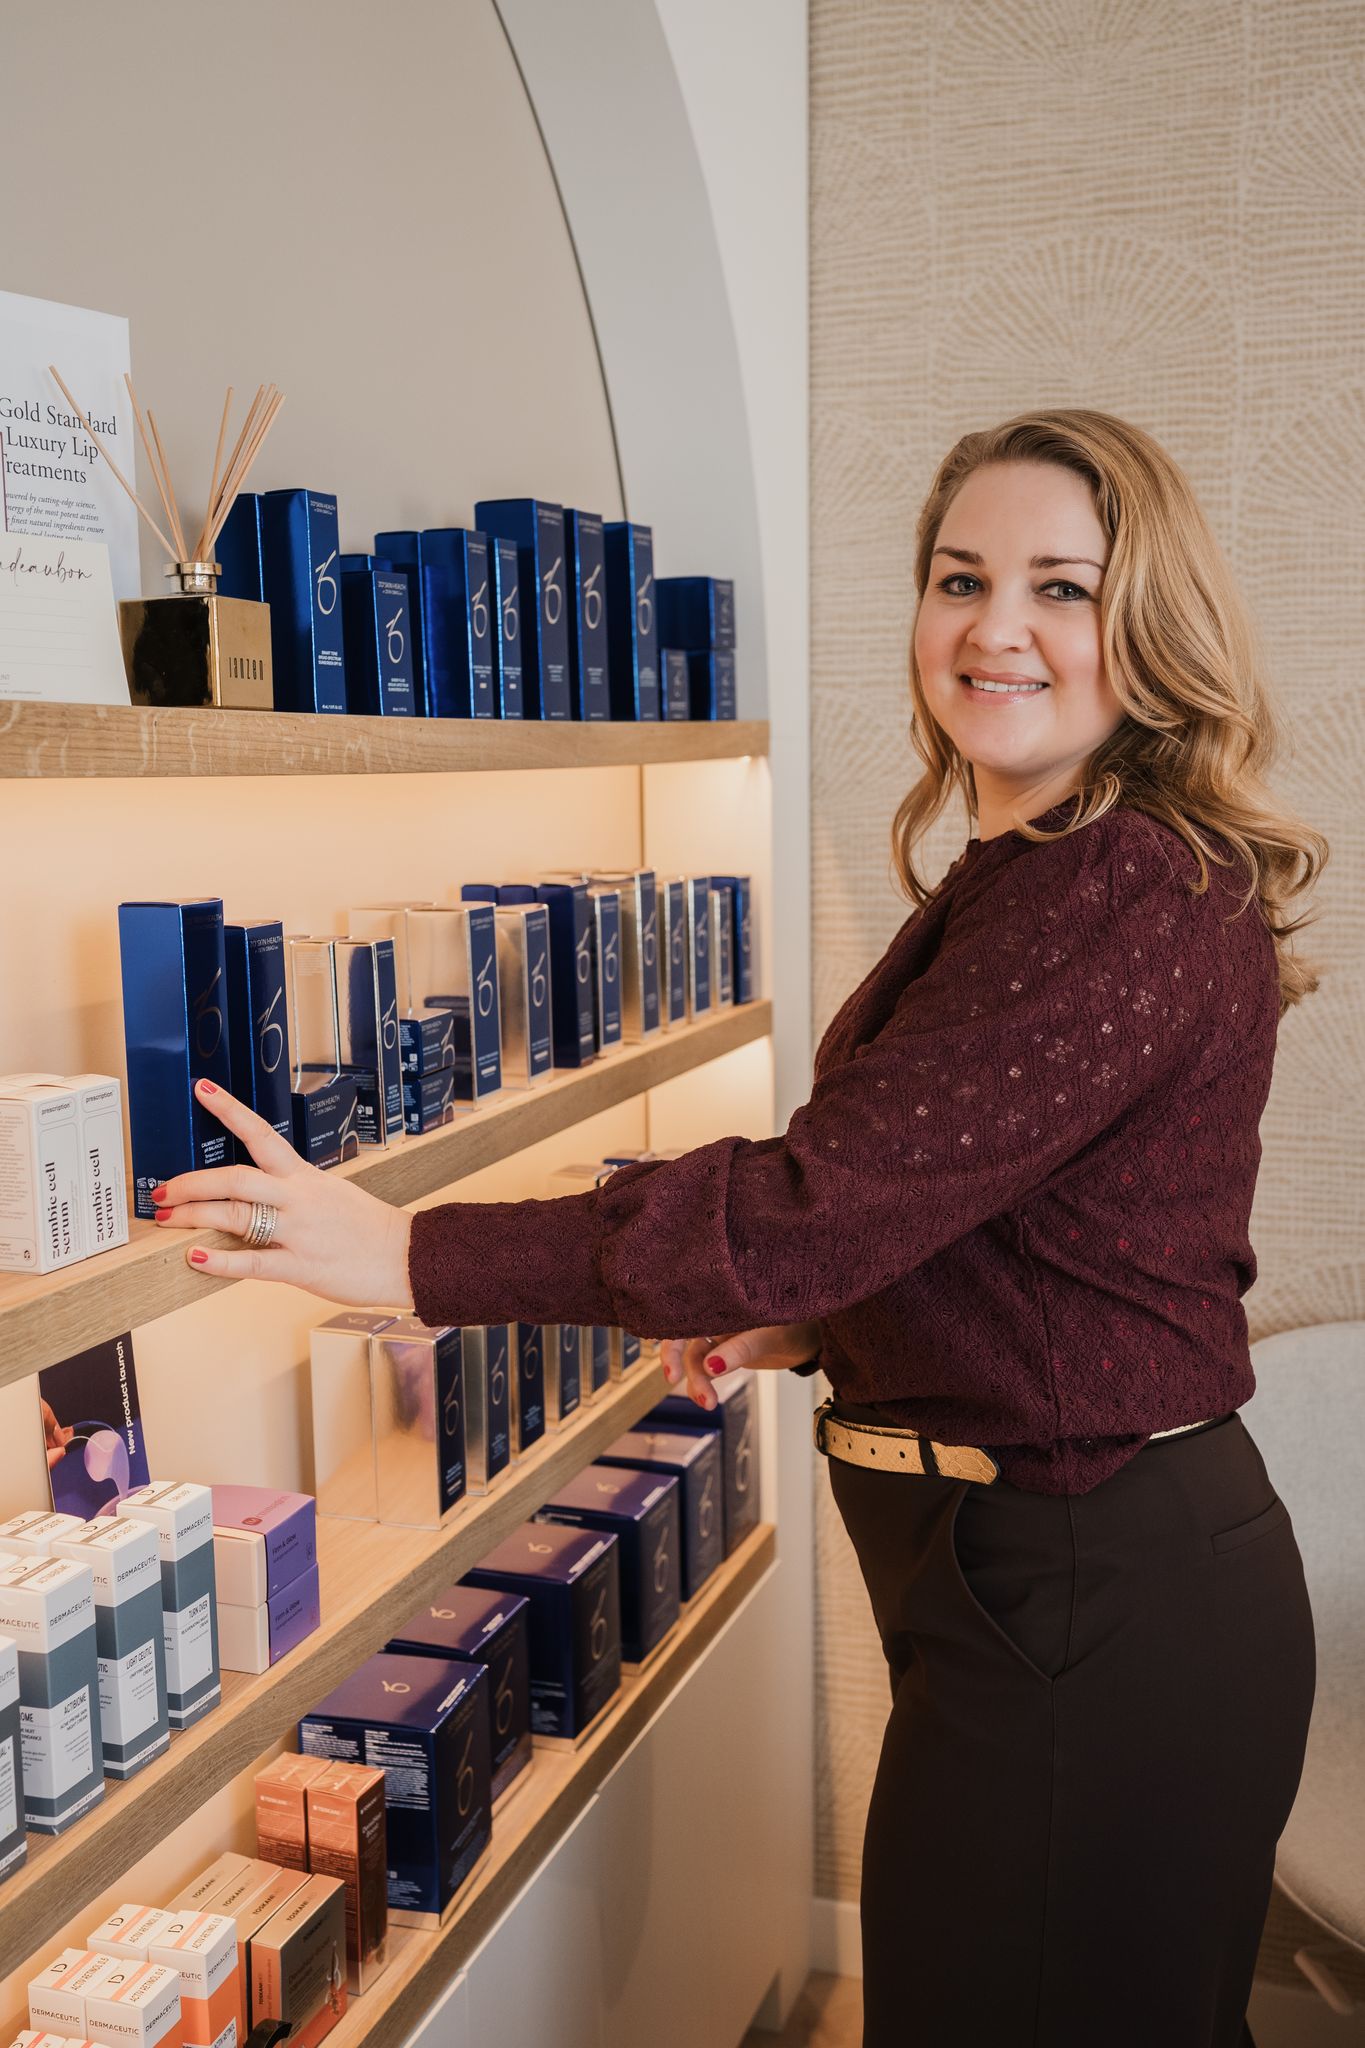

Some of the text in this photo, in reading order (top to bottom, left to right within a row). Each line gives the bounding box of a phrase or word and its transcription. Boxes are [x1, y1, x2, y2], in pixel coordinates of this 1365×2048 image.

[0, 397, 40, 423] Gold
[6, 426, 98, 464] Luxury Lip
[41, 1102, 71, 1116] prescription
[85, 1090, 114, 1104] prescription
[45, 1161, 57, 1192] cell
[89, 1148, 101, 1178] cell
[104, 1186, 114, 1238] serum
[61, 1201, 71, 1255] serum
[115, 1341, 136, 1455] New product launch
[176, 1513, 211, 1540] DERMACEUTIC
[117, 1554, 157, 1583] DERMACEUTIC
[49, 1595, 92, 1627] DERMACEUTIC
[126, 1654, 138, 1670] LIGHT
[64, 1692, 87, 1715] ACTIBIOME
[207, 1942, 236, 1977] DERMACEUTIC
[31, 2007, 80, 2024] DERMACEUTIC
[89, 2019, 139, 2036] DERMACEUTIC
[145, 1995, 180, 2032] DERMACEUTIC
